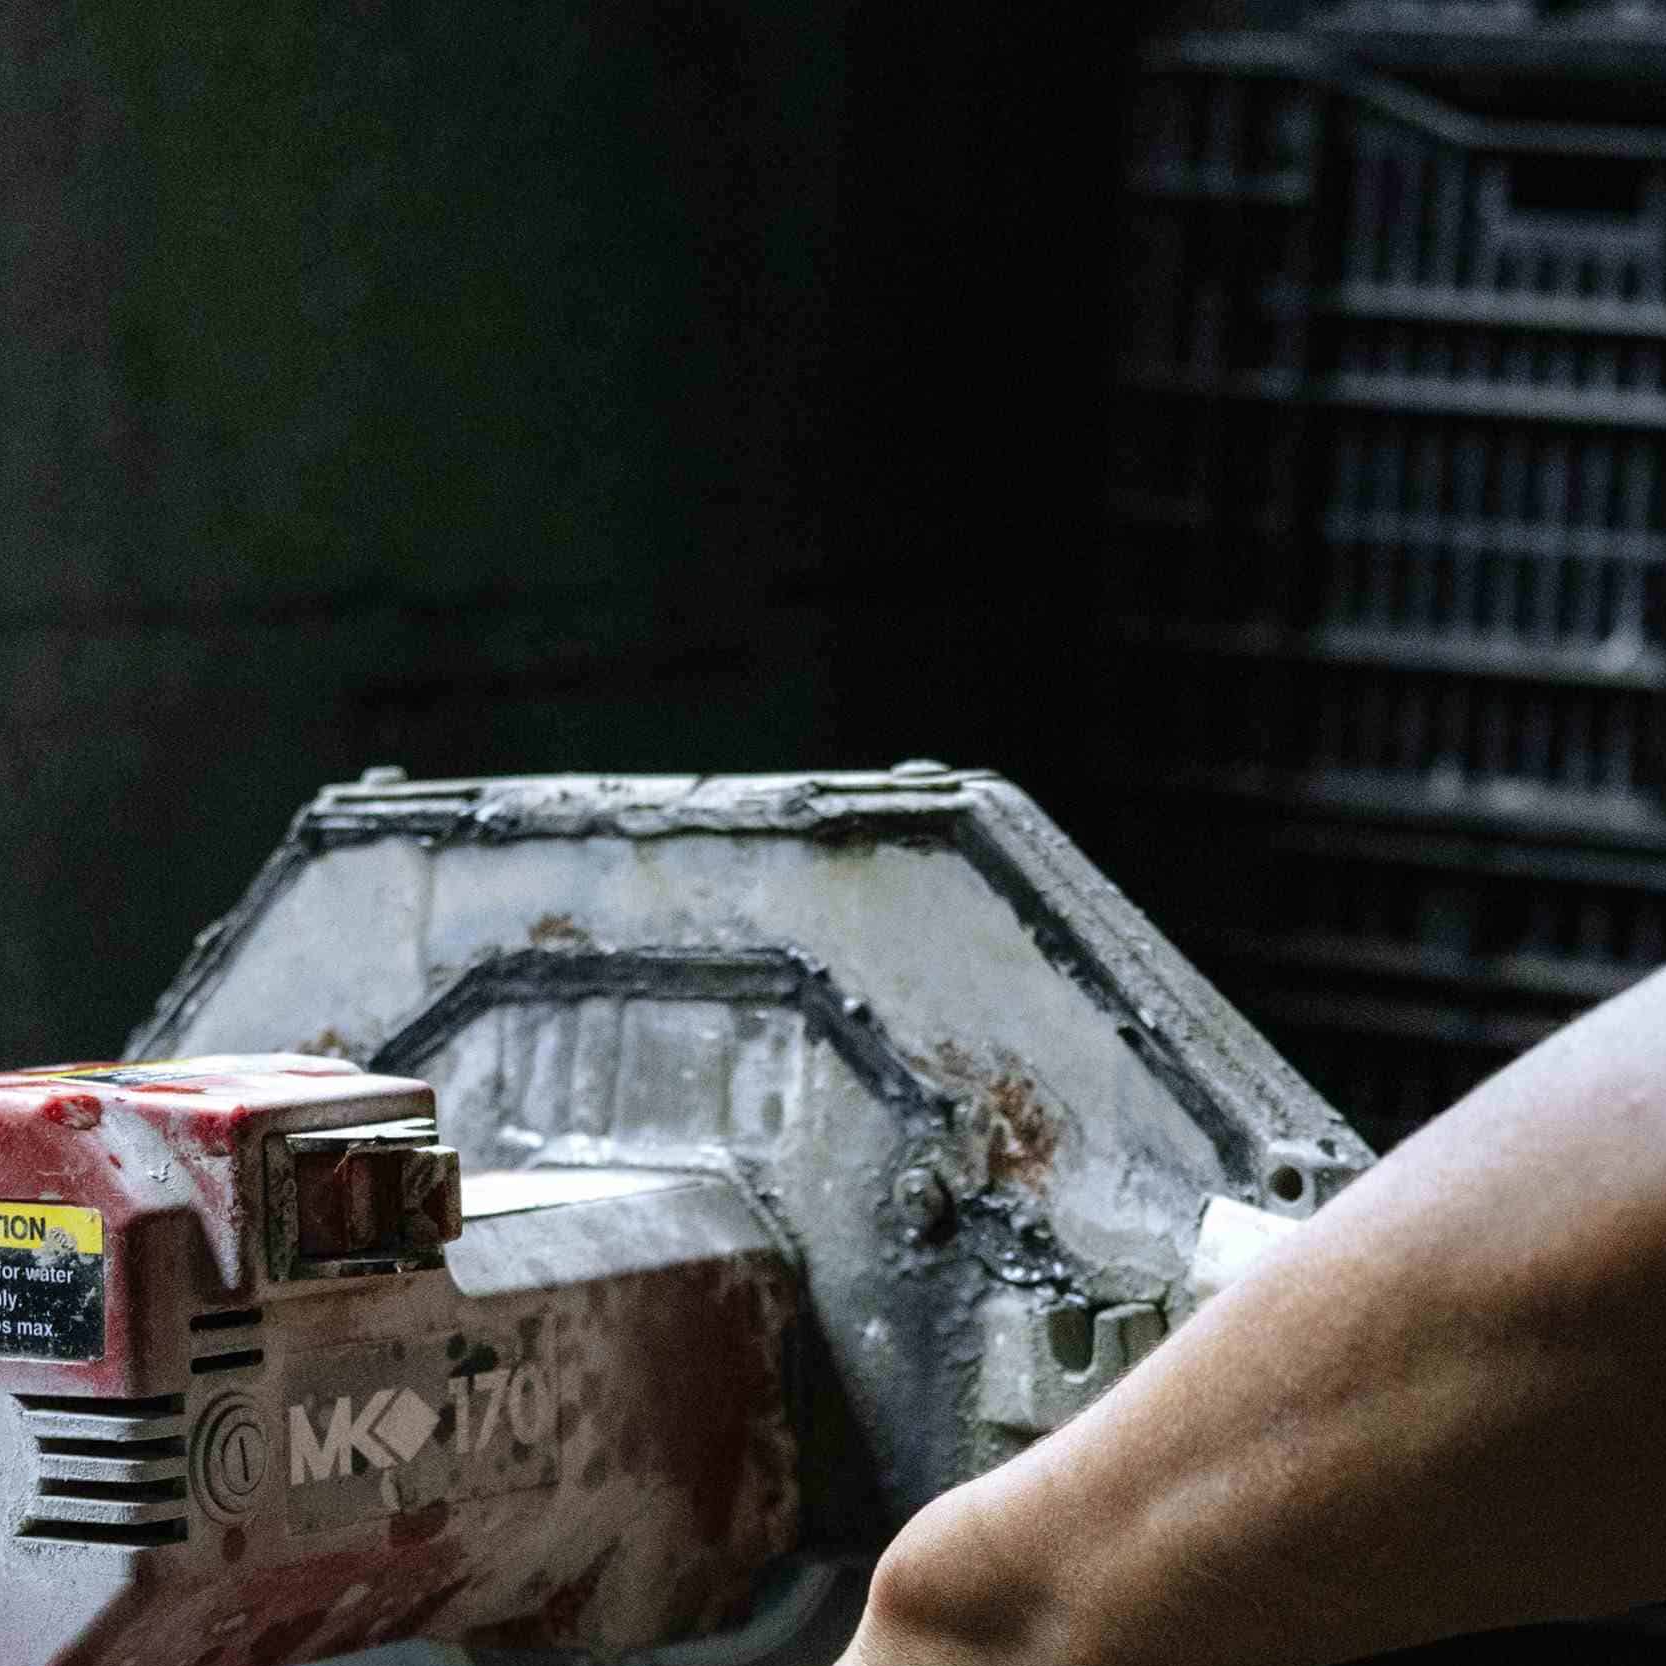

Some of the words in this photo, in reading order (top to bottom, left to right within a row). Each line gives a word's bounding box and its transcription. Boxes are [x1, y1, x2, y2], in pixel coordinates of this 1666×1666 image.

[25, 1266, 74, 1283] water
[17, 1322, 59, 1337] max.
[289, 1387, 398, 1486] MK
[448, 1366, 558, 1454] 170
